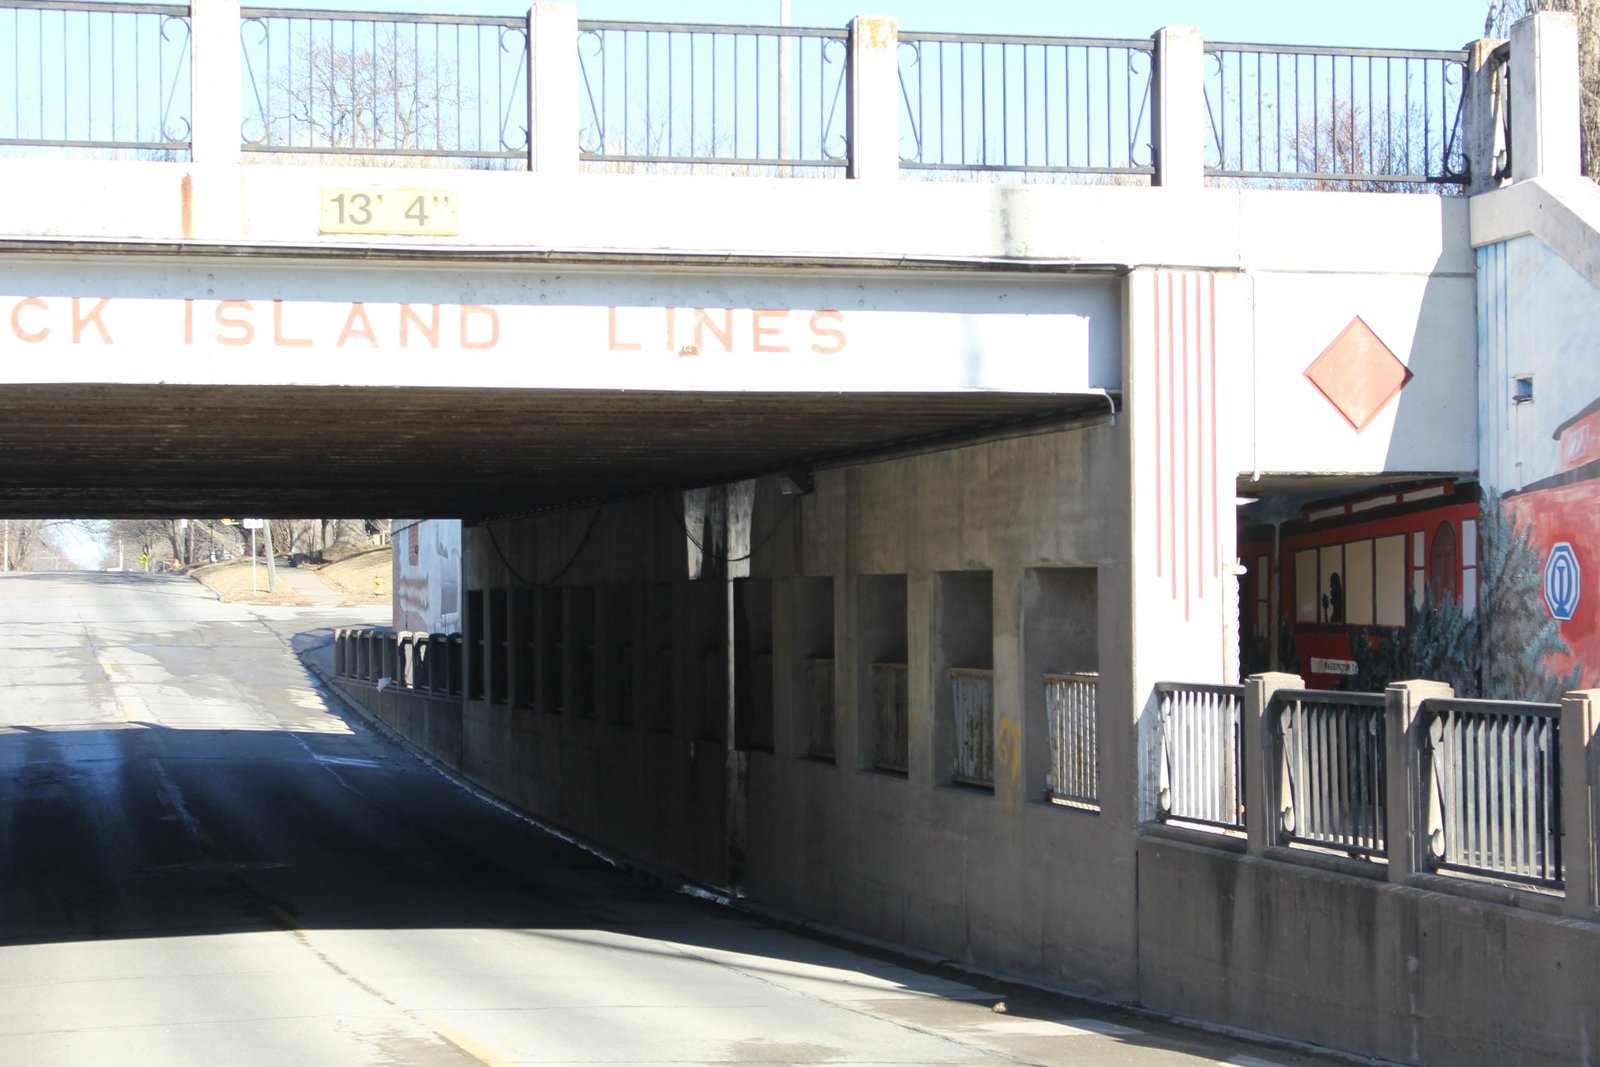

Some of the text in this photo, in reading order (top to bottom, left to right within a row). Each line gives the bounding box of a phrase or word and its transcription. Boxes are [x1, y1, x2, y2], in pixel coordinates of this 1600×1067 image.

[330, 192, 383, 226] 13'
[184, 297, 500, 350] ISLAND
[608, 305, 847, 354] LINES
